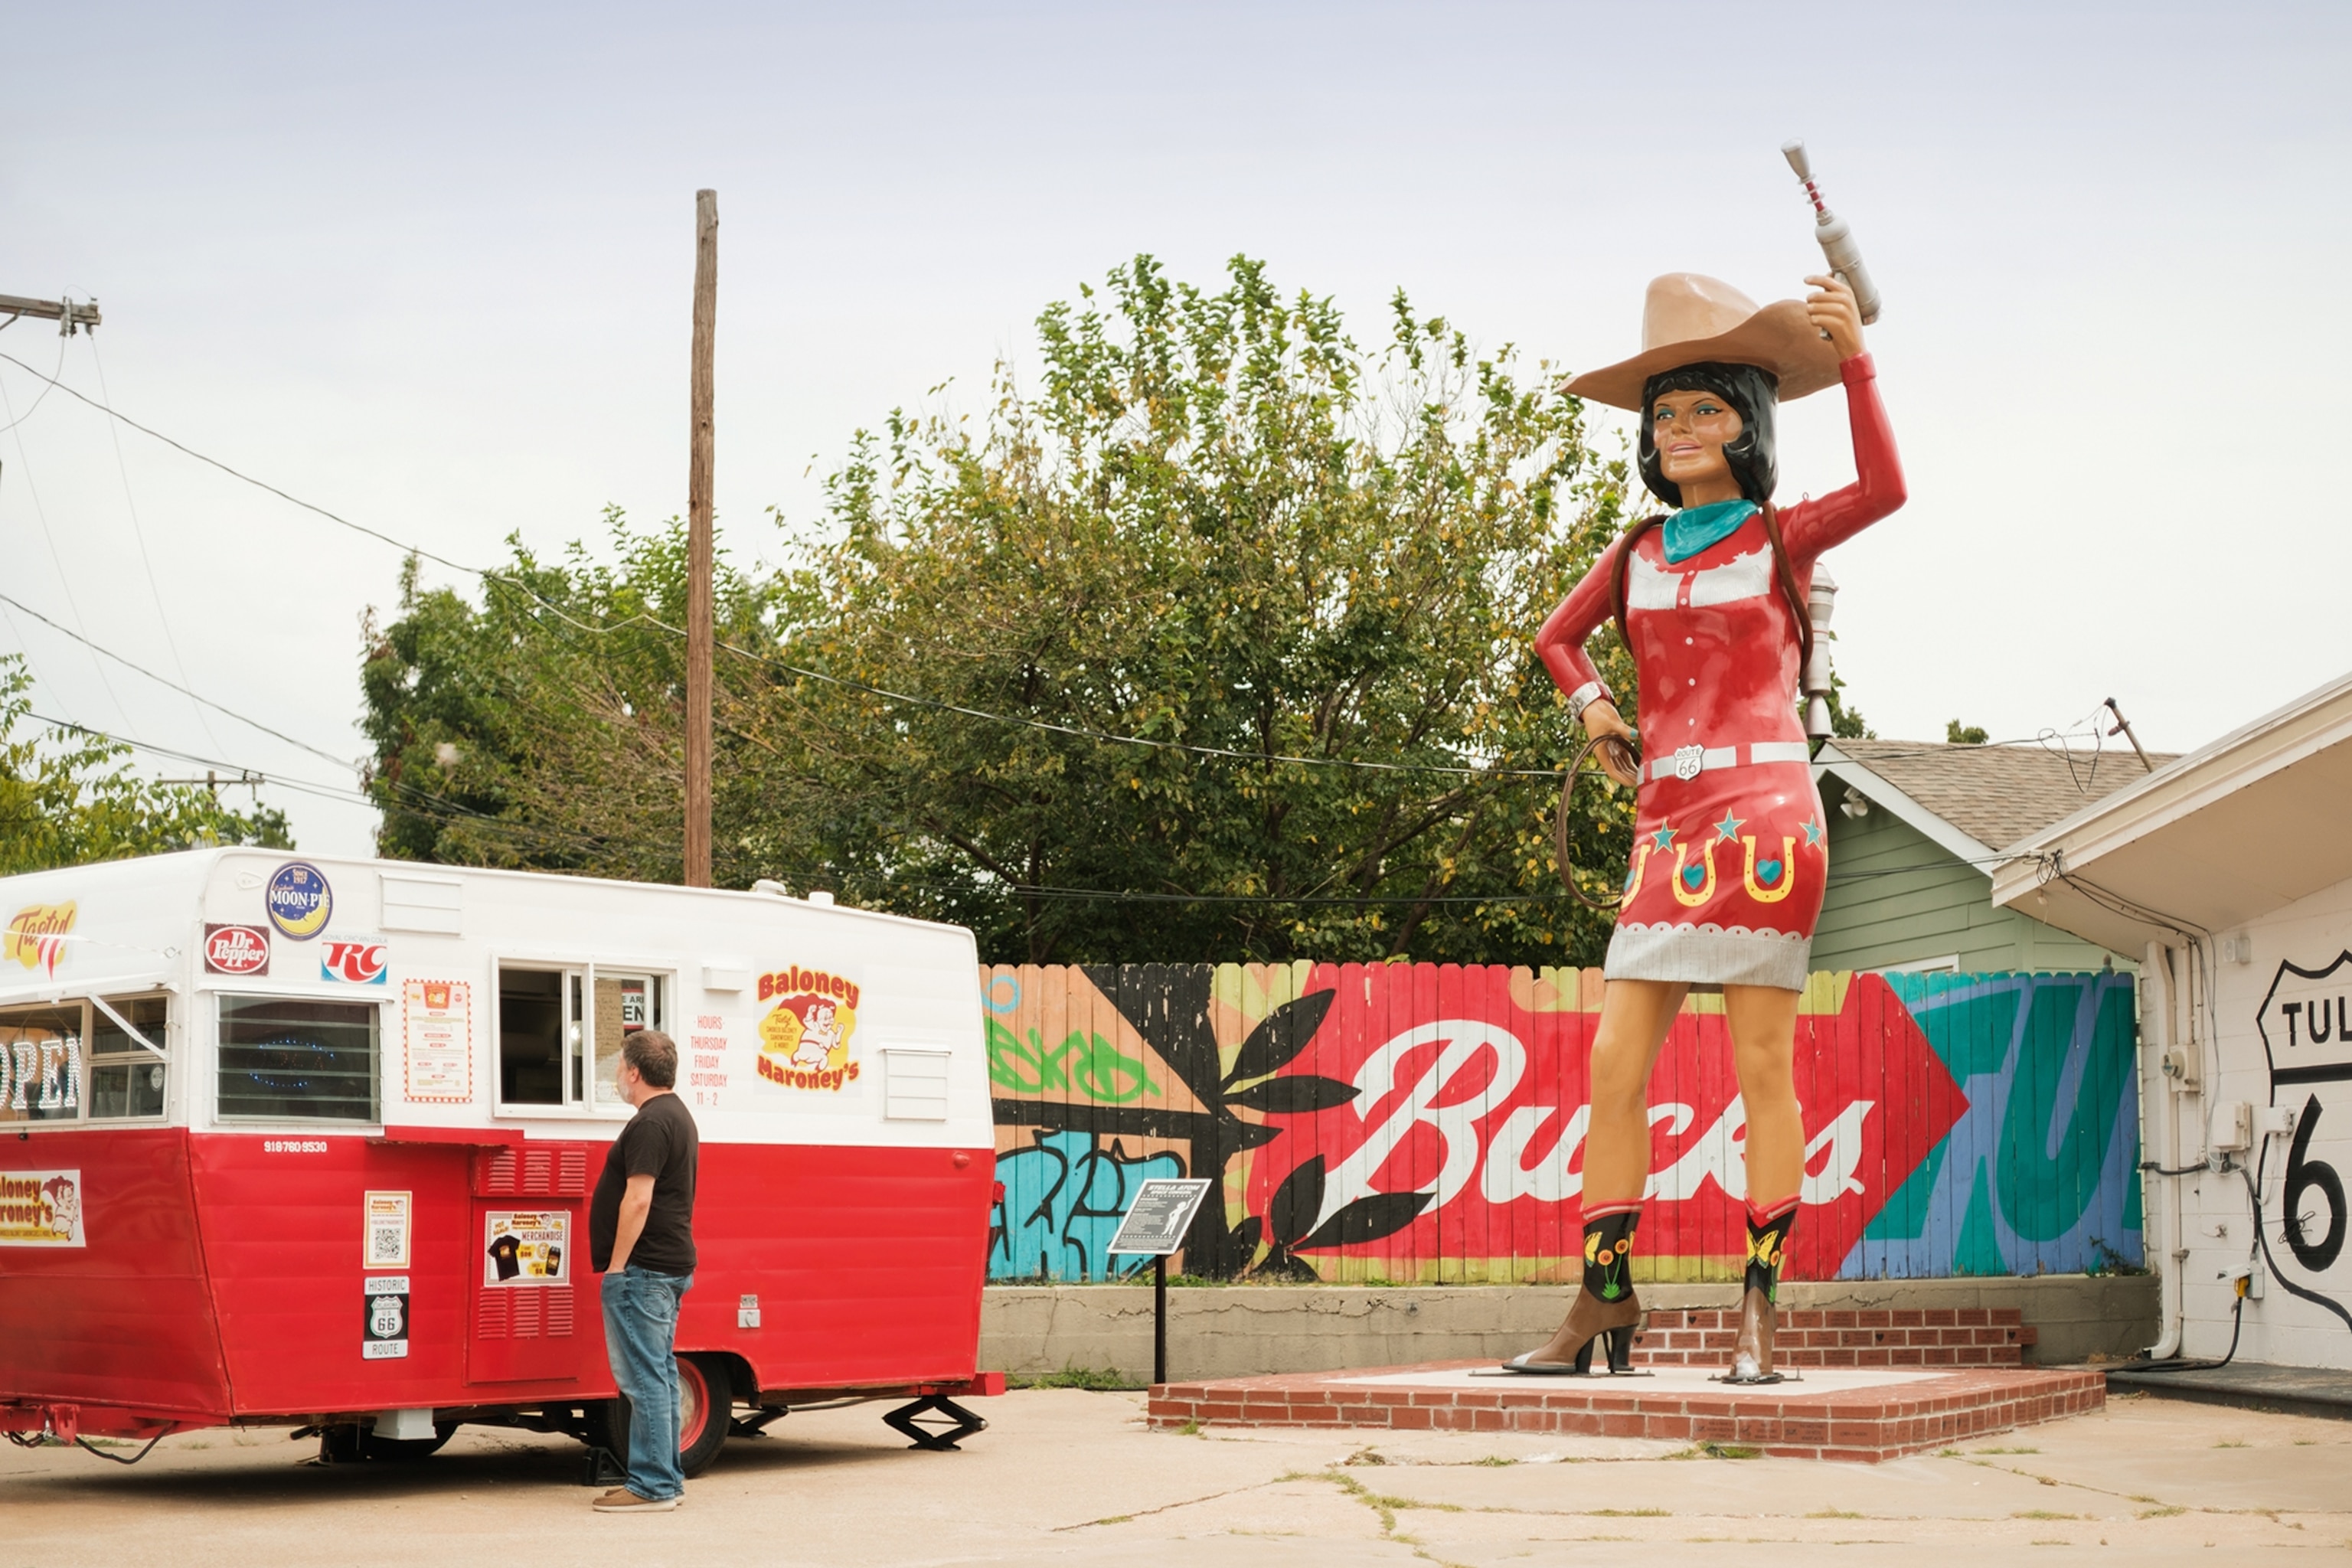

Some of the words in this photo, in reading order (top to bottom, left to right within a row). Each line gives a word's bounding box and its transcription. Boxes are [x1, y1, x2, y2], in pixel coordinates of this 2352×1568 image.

[1677, 749, 1700, 758] ROUTE
[1679, 759, 1697, 776] 66
[229, 931, 254, 949] Dr
[211, 939, 265, 968] Pepper
[322, 942, 387, 981] RC
[759, 965, 859, 1010] Baloney
[697, 1015, 723, 1030] HOURS
[2282, 996, 2352, 1047] TUL
[691, 1036, 728, 1051] THURSDAY
[694, 1054, 720, 1069] FRIDAY
[691, 1073, 728, 1087] SATURDAY
[758, 1055, 858, 1091] Maroney's
[697, 1092, 704, 1105] 11
[713, 1092, 718, 1106] 2
[0, 1176, 41, 1204] loney
[521, 1231, 563, 1240] MERCHANDISE
[368, 1279, 406, 1291] HISTORIC
[378, 1318, 394, 1331] 66
[372, 1344, 398, 1355] ROUTE
